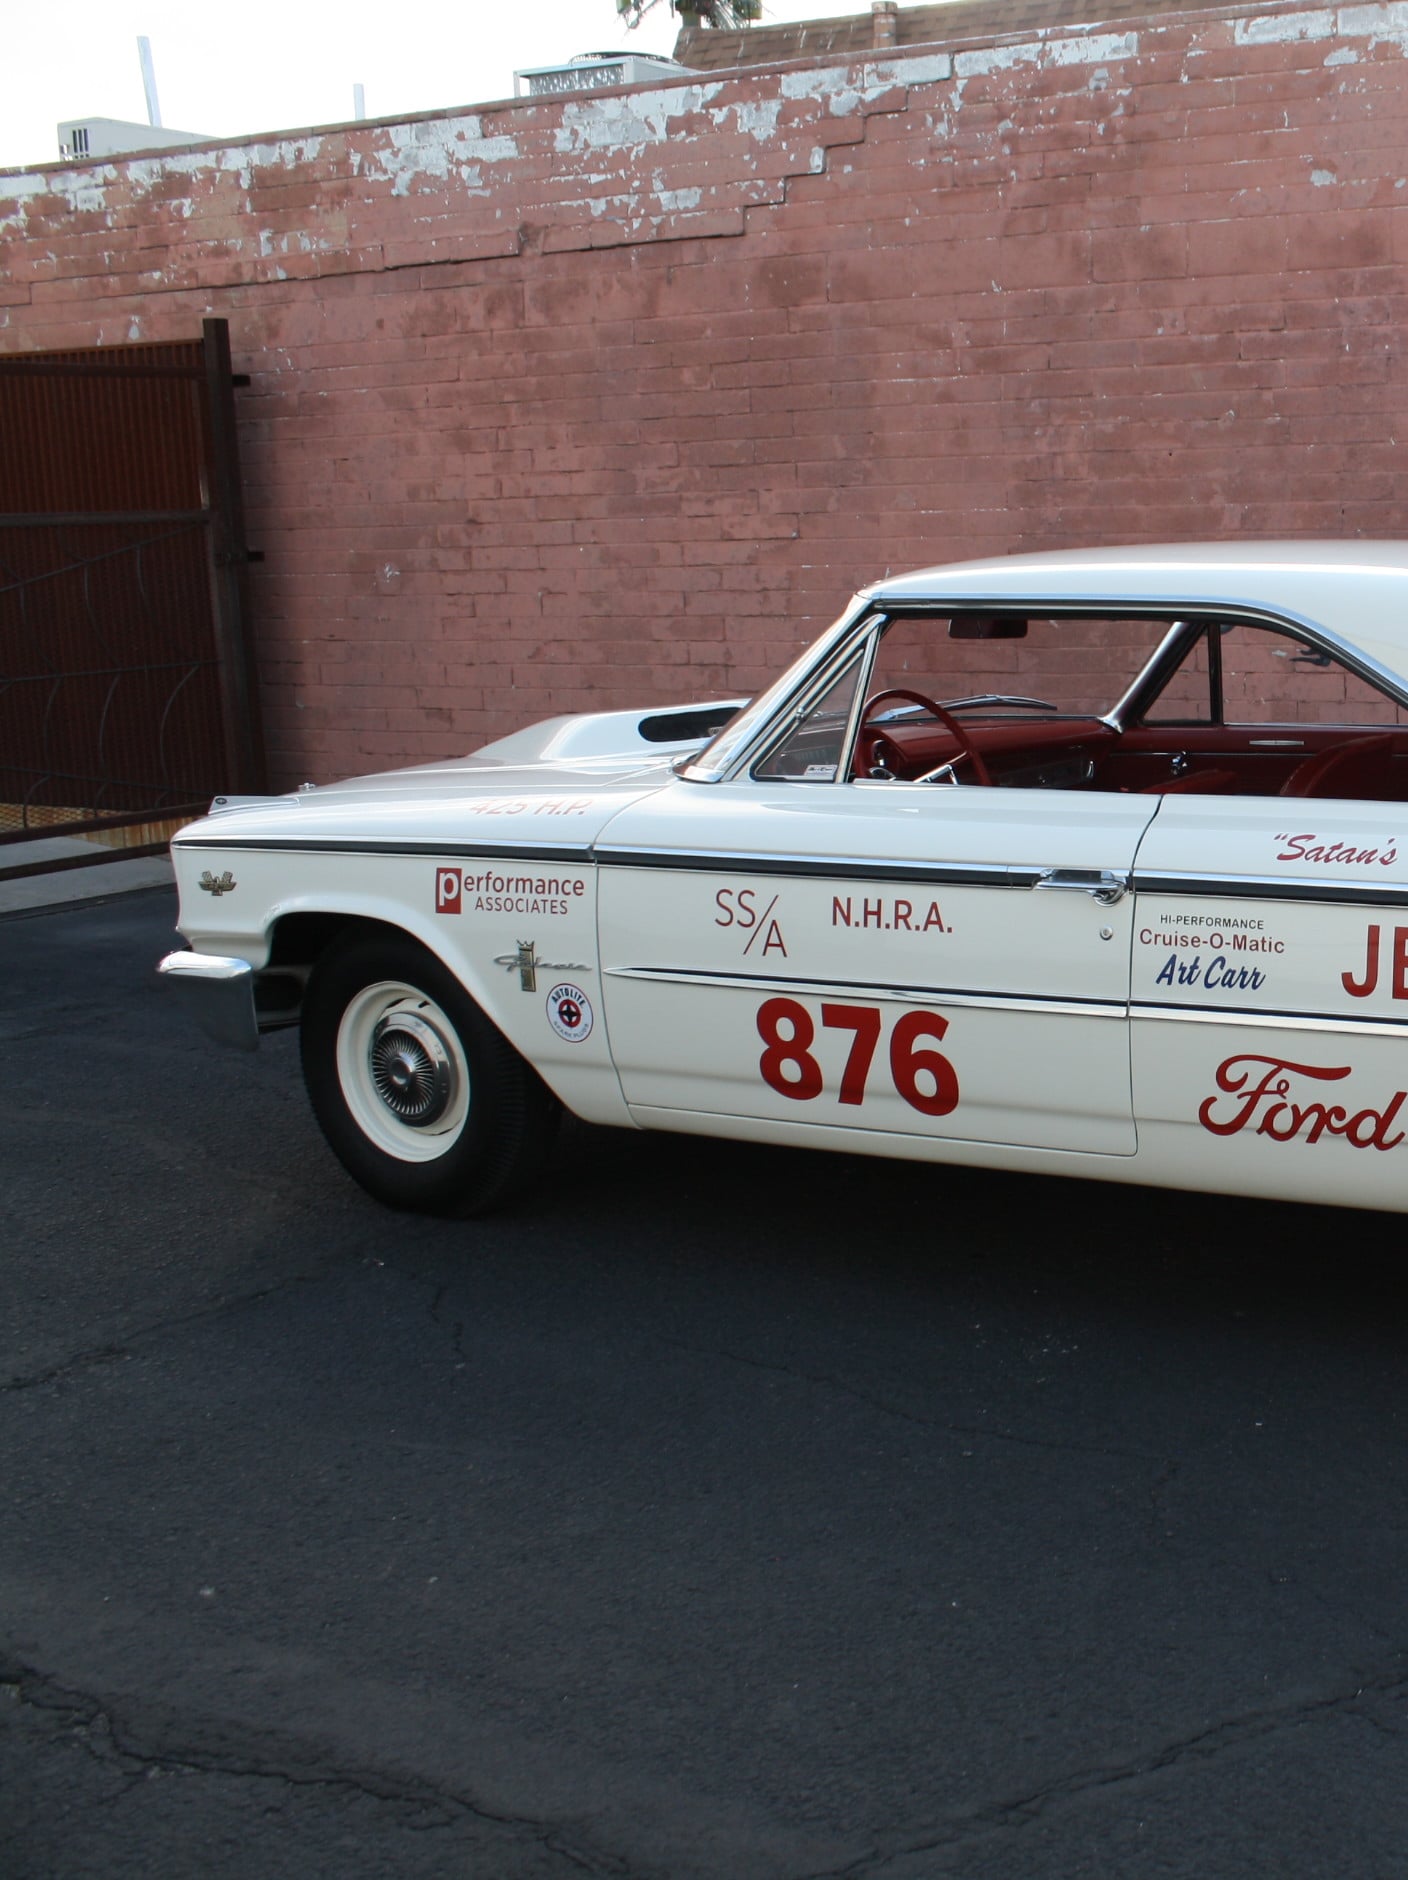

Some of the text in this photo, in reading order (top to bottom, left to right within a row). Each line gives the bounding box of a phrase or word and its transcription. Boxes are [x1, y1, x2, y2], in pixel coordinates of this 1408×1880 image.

[533, 800, 593, 816] H.P.
[438, 868, 585, 906] performance
[474, 896, 569, 915] ASSOCIATES
[831, 896, 953, 933] N.H.R.A.
[1160, 914, 1265, 930] HI-PERFORMANCE
[1139, 928, 1286, 954] Cruise-O-Matic
[1155, 953, 1267, 991] Art Carr
[551, 986, 587, 1008] AUTOLITE
[755, 997, 960, 1117] 876
[1199, 1053, 1408, 1151] Ford
